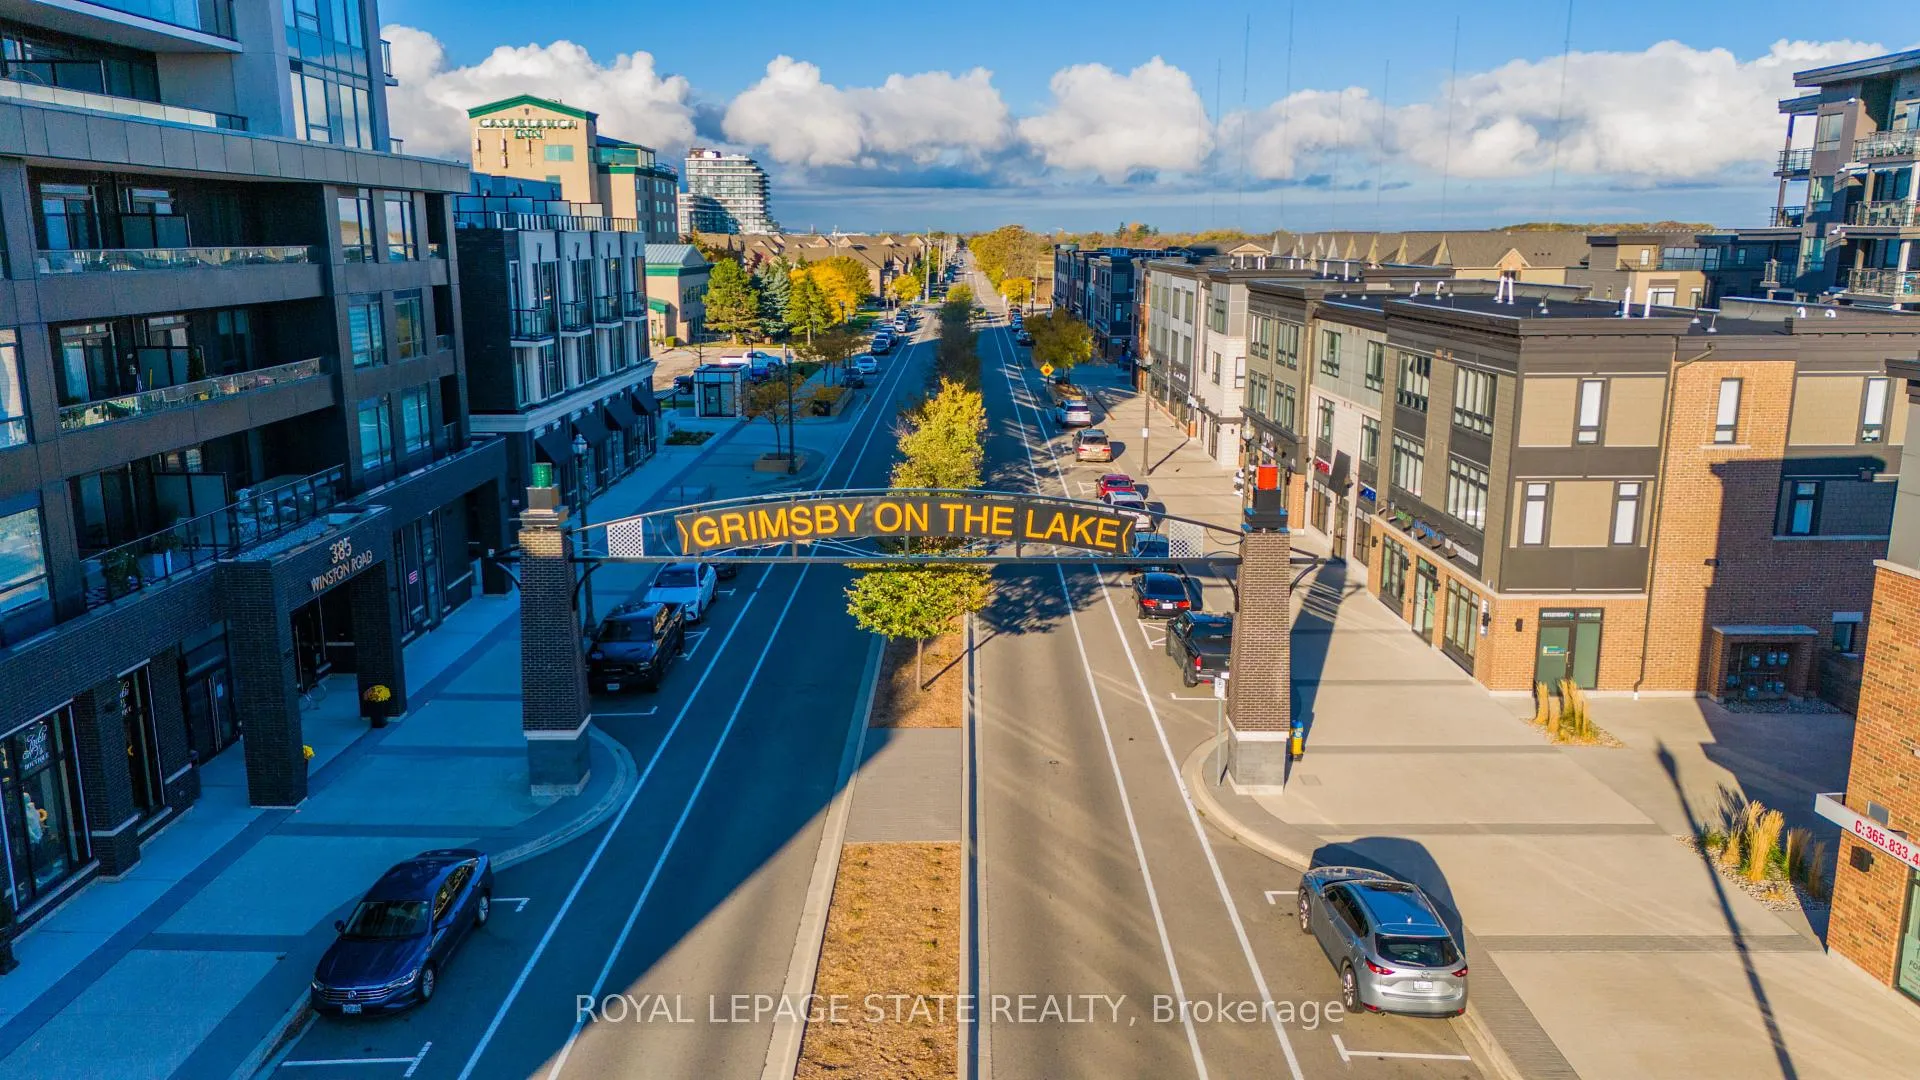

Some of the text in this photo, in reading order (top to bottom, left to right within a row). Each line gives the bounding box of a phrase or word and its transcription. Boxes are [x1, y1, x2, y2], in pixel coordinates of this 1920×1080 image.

[479, 118, 578, 130] CASABLANCA
[514, 128, 545, 139] INN
[691, 502, 1121, 549] GRIMSBY ON THE LAKE
[329, 536, 352, 564] 385
[311, 550, 373, 593] WINSTON ROAD
